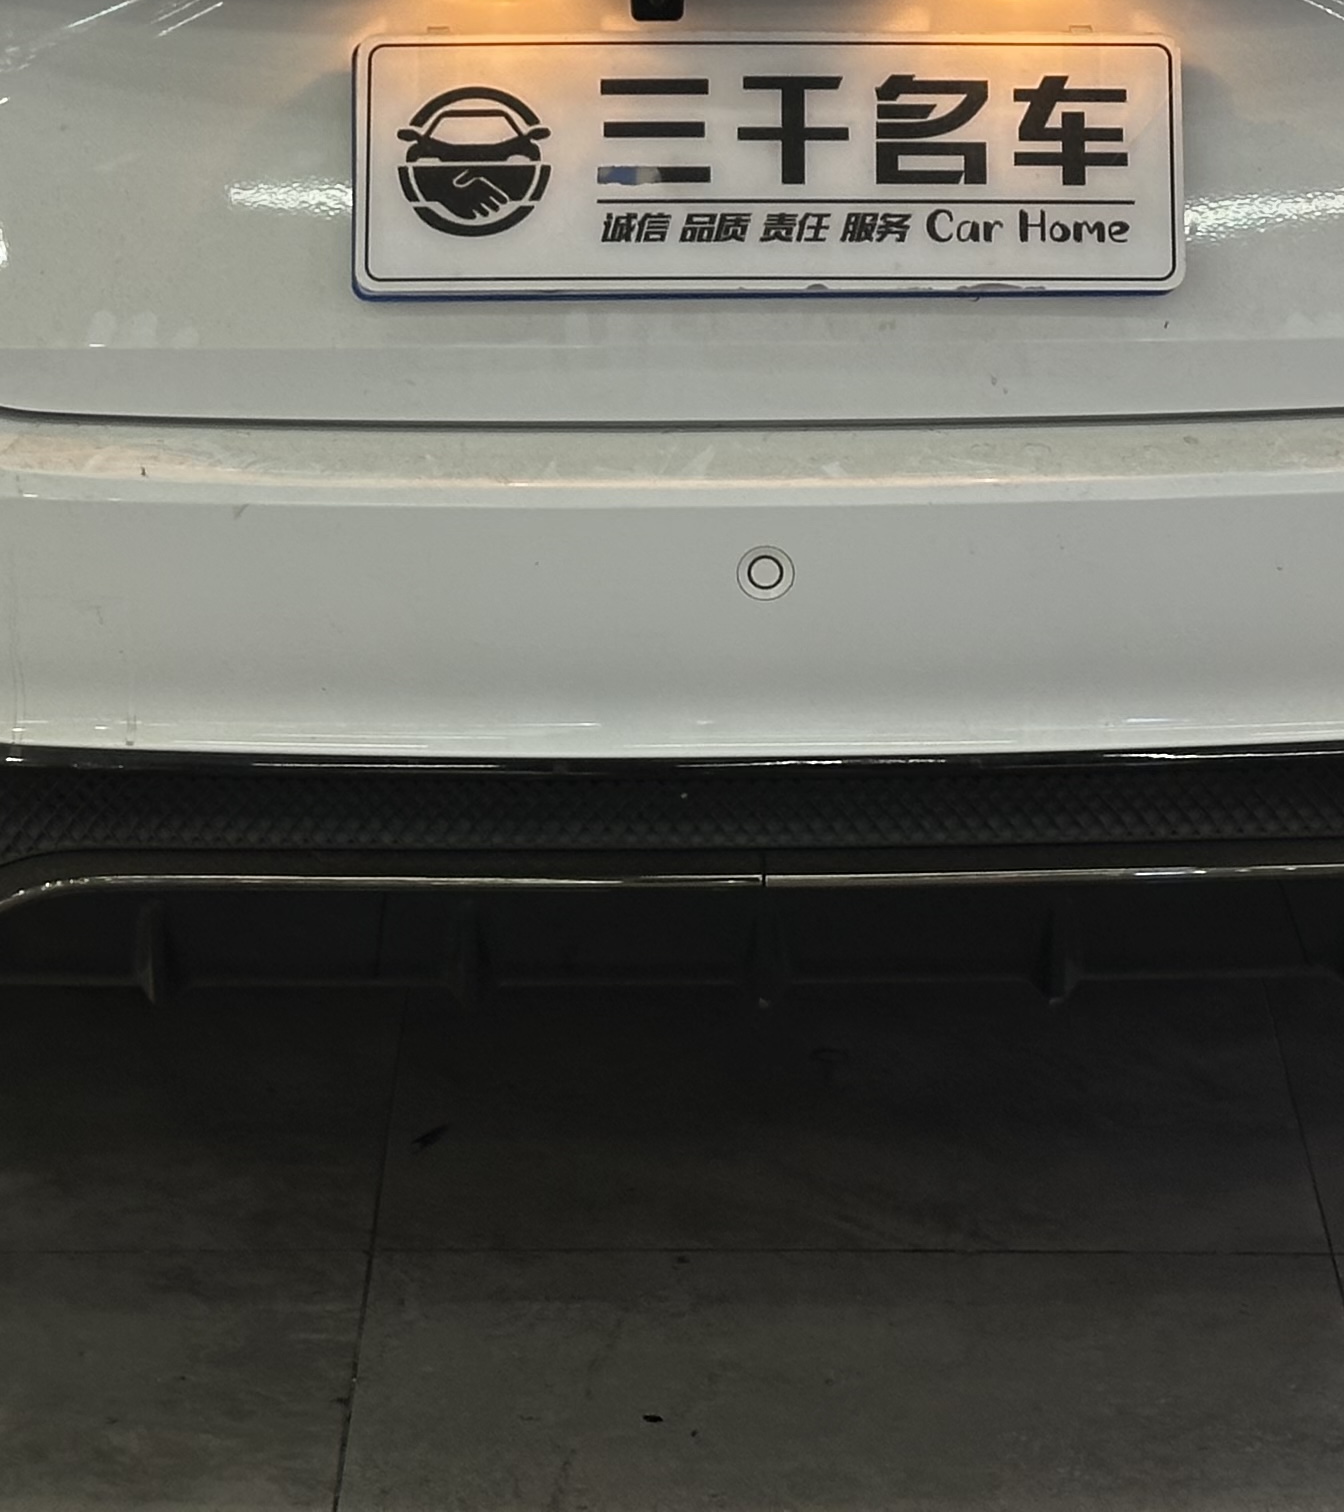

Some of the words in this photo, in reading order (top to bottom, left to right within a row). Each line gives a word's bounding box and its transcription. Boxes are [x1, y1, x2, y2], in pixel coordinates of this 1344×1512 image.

[600, 212, 672, 243] 诚信
[679, 212, 752, 243] 品质
[759, 212, 831, 243] 责任
[840, 212, 912, 243] 服务
[925, 208, 1004, 243] Car
[1018, 209, 1131, 244] Home
